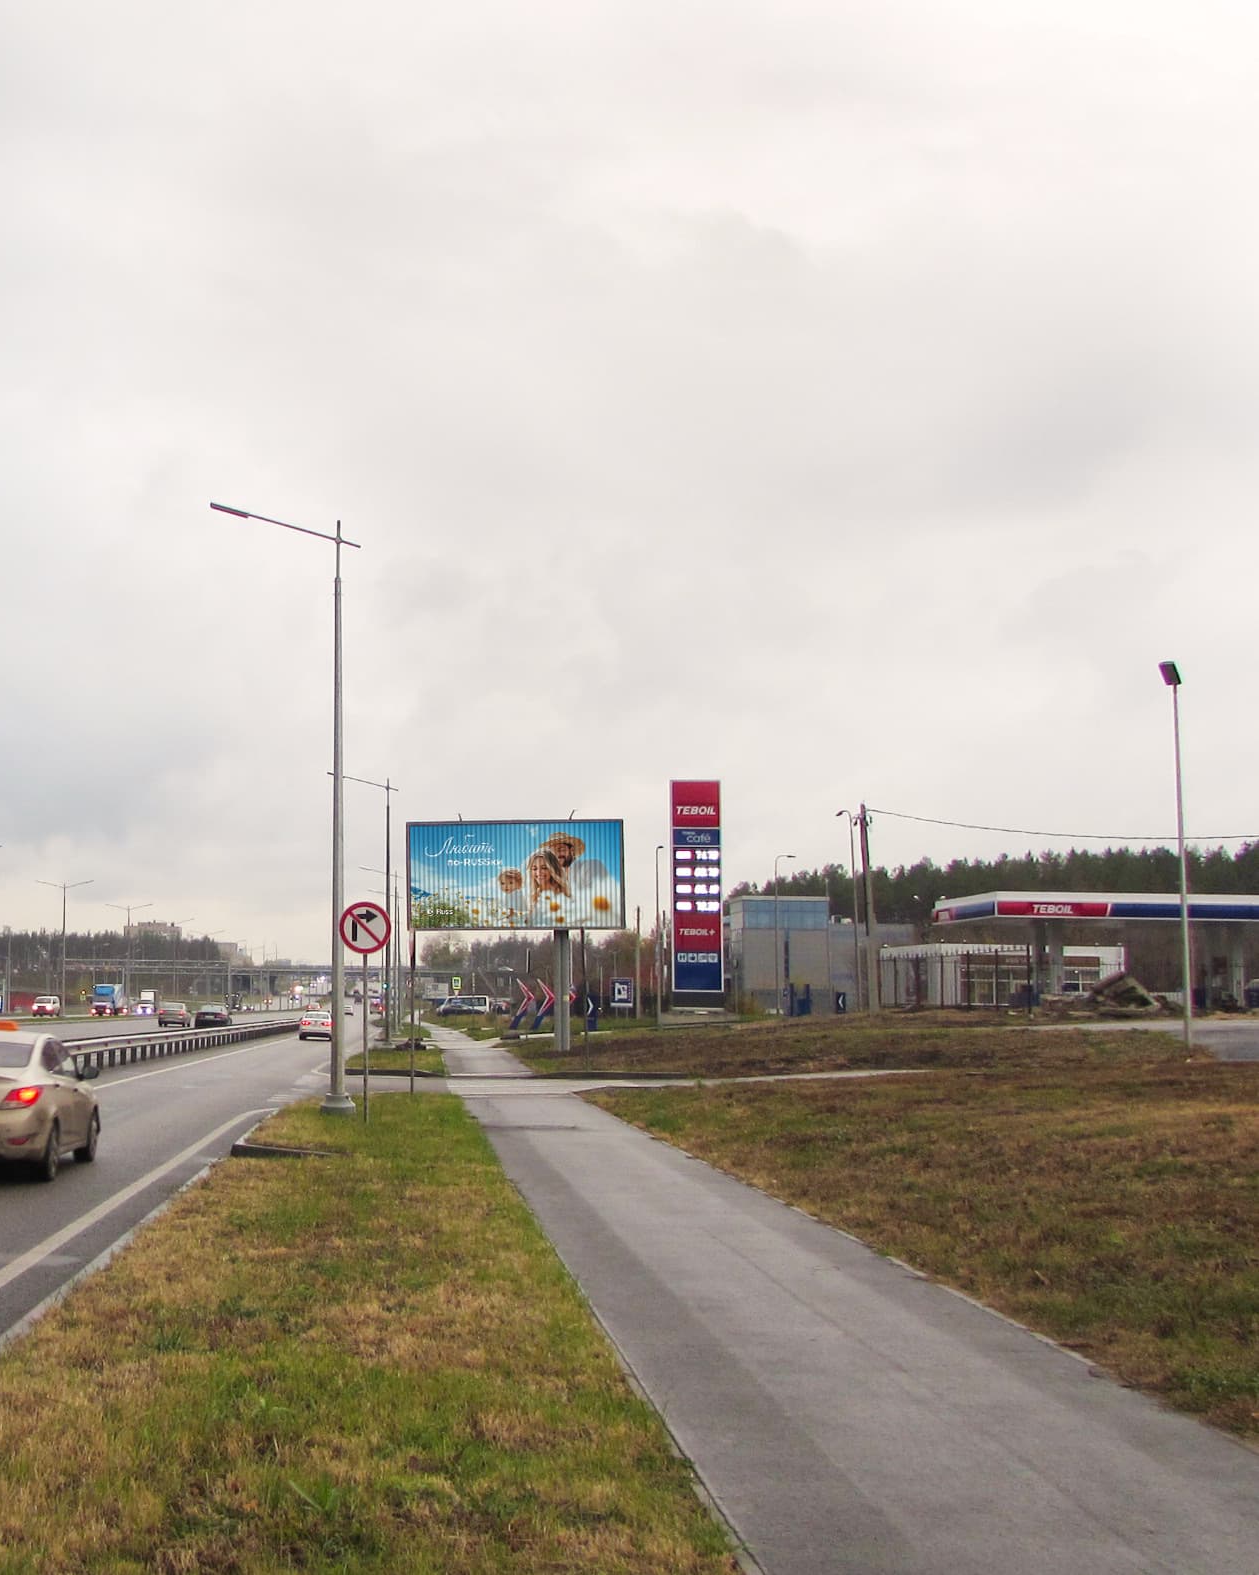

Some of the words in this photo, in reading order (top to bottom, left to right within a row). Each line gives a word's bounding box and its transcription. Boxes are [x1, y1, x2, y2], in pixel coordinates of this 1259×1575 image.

[676, 806, 716, 815] TEBOIL
[686, 831, 711, 843] café
[1033, 904, 1073, 914] TEBOIL
